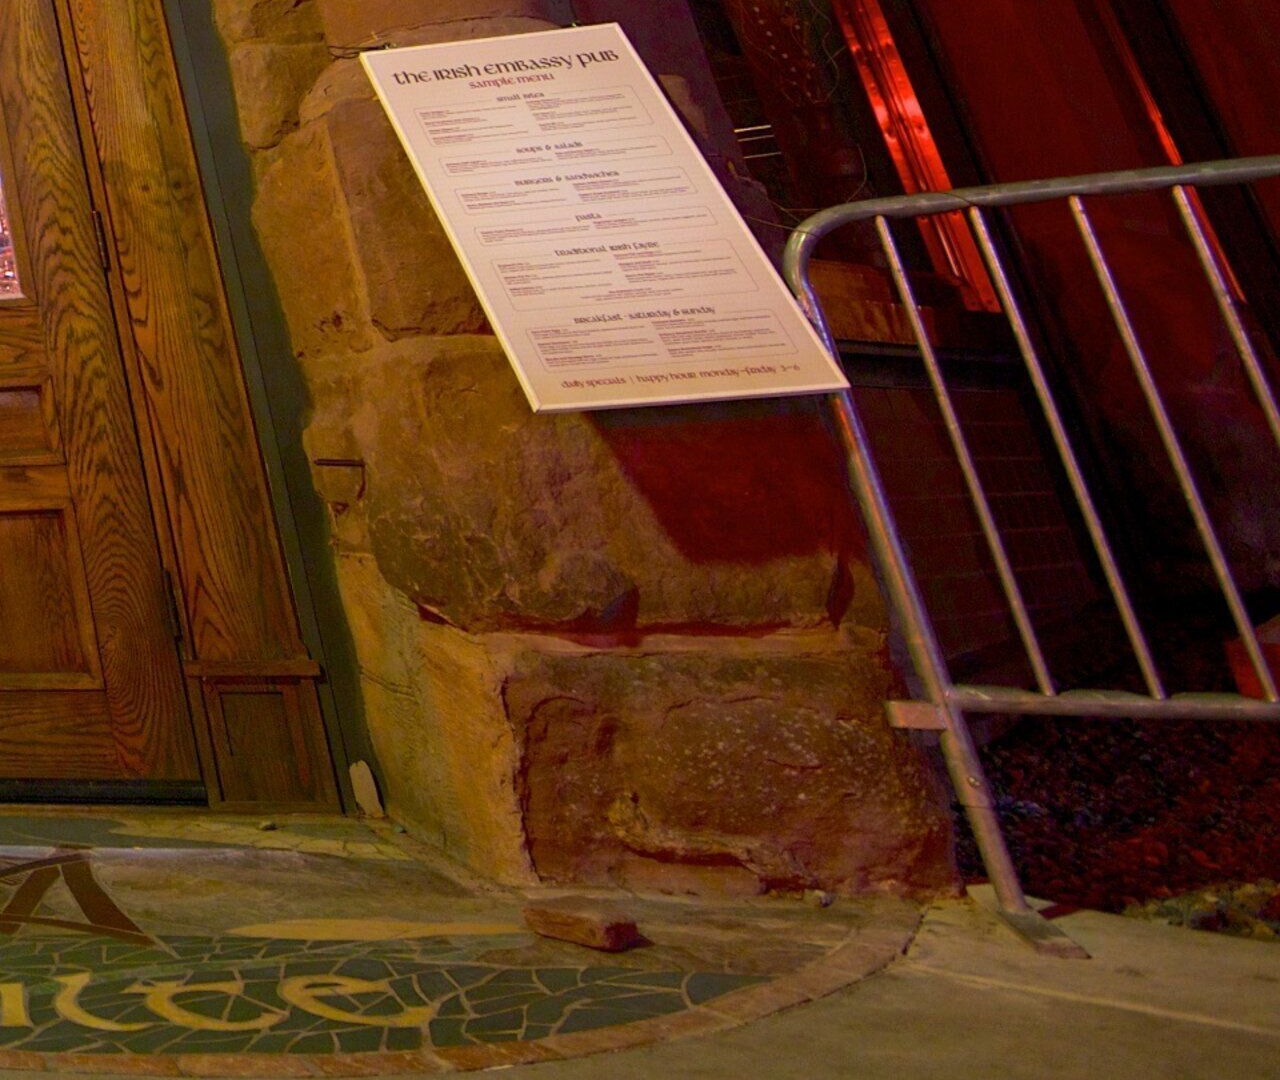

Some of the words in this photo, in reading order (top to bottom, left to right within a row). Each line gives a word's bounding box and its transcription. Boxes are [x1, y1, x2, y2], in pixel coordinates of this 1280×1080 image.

[469, 76, 517, 90] sample
[517, 73, 555, 85] menu
[496, 93, 521, 103] small
[575, 213, 602, 222] pasta
[554, 245, 608, 256] traditional
[561, 378, 585, 390] daily
